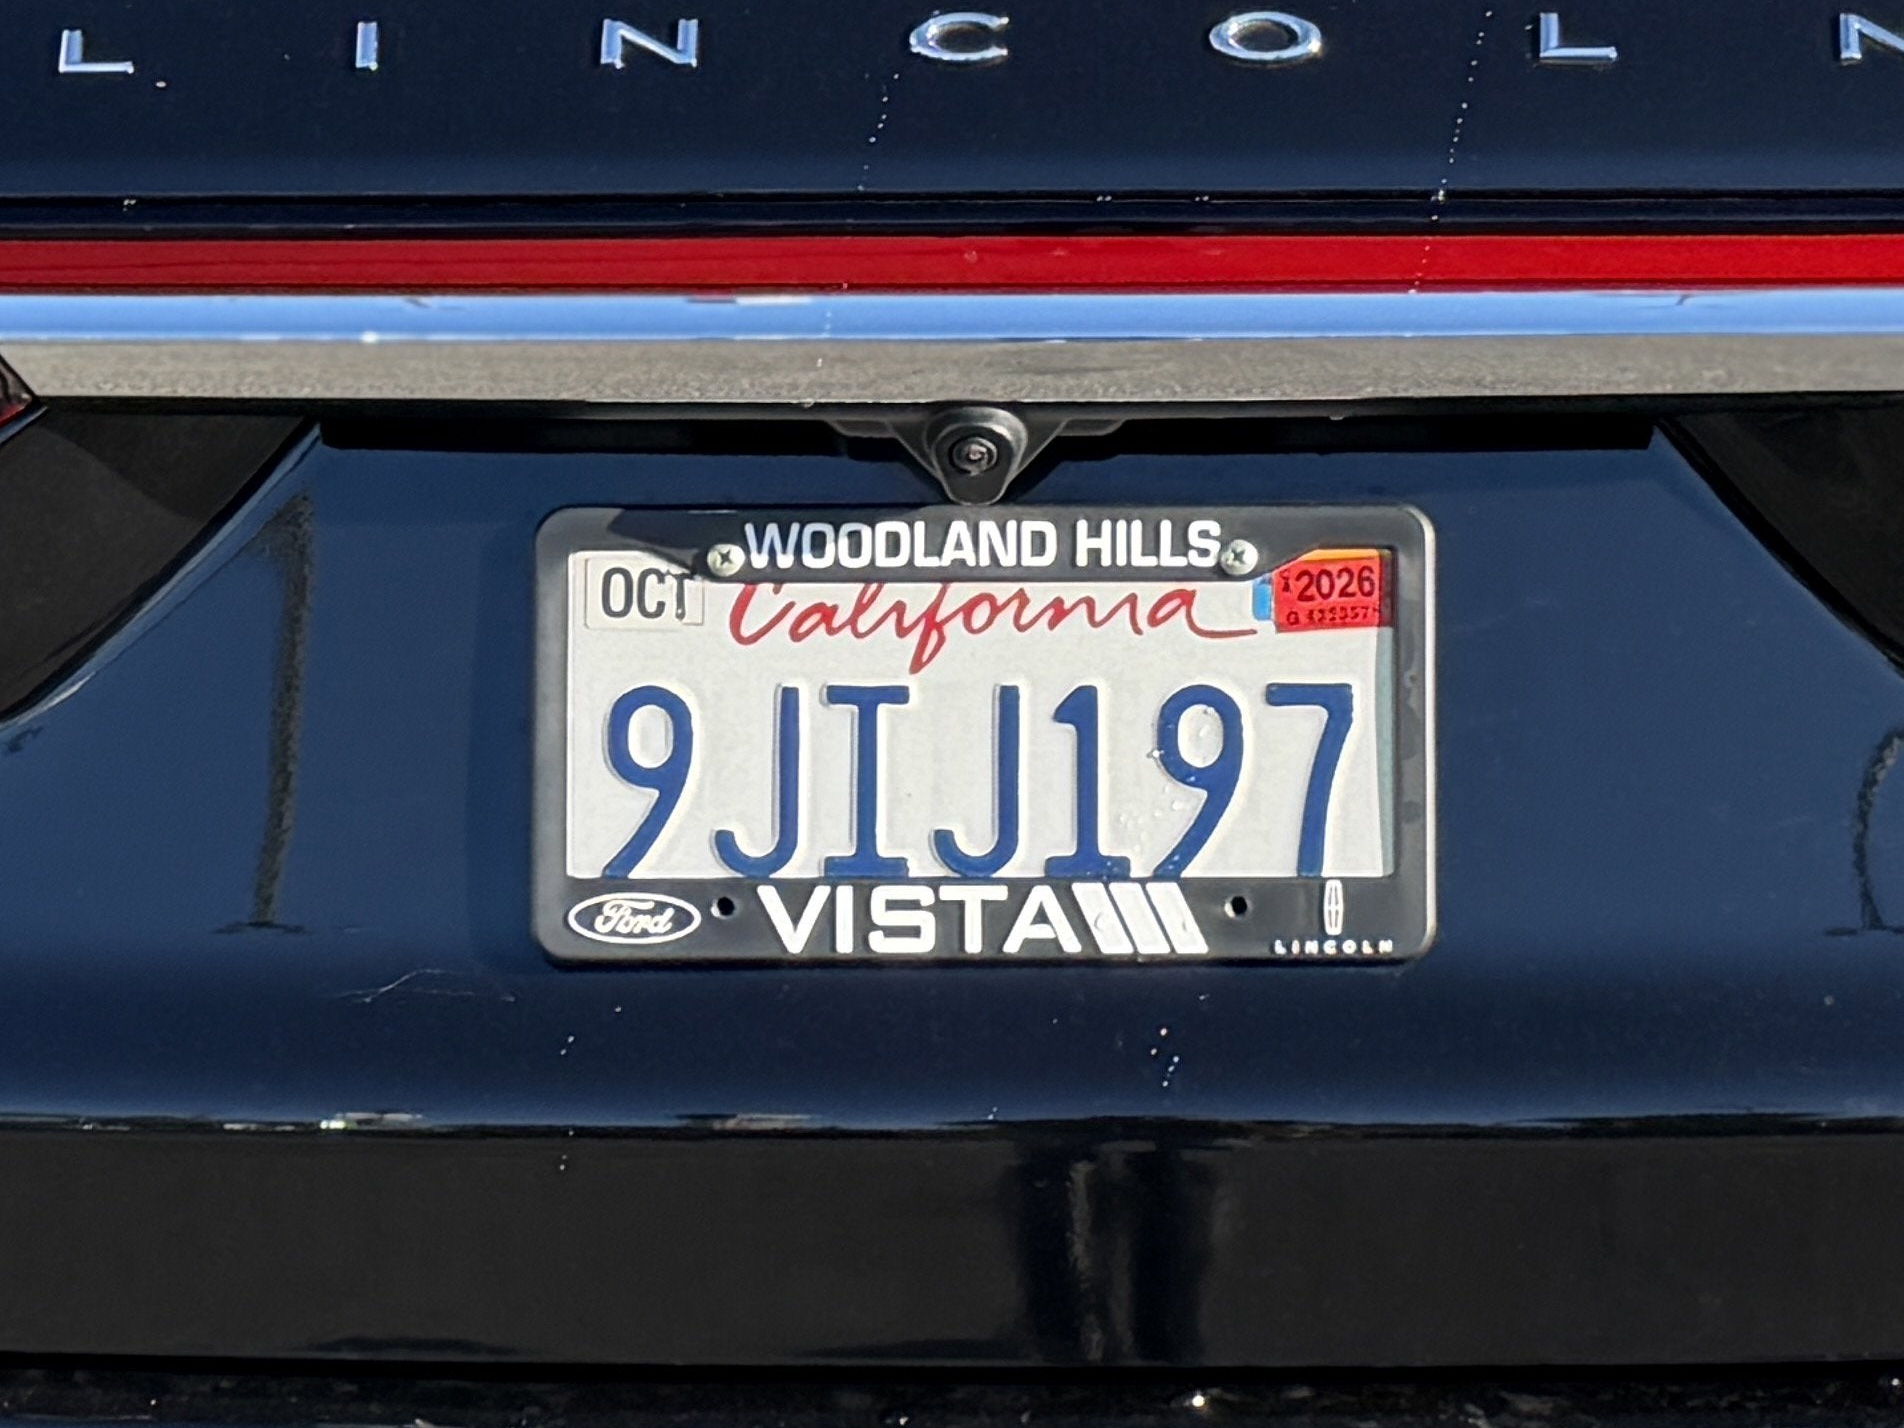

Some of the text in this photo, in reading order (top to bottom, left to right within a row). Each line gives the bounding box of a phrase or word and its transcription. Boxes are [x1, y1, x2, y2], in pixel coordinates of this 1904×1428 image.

[744, 518, 1223, 570] WOODLAND HILLS
[601, 566, 692, 621] OCT
[1295, 565, 1376, 602] 2026
[729, 582, 1258, 675] California
[605, 683, 1355, 877] 9JIJ197
[595, 898, 675, 935] Ford
[756, 884, 1083, 955] VISTA
[1273, 938, 1394, 956] LINCOLN
